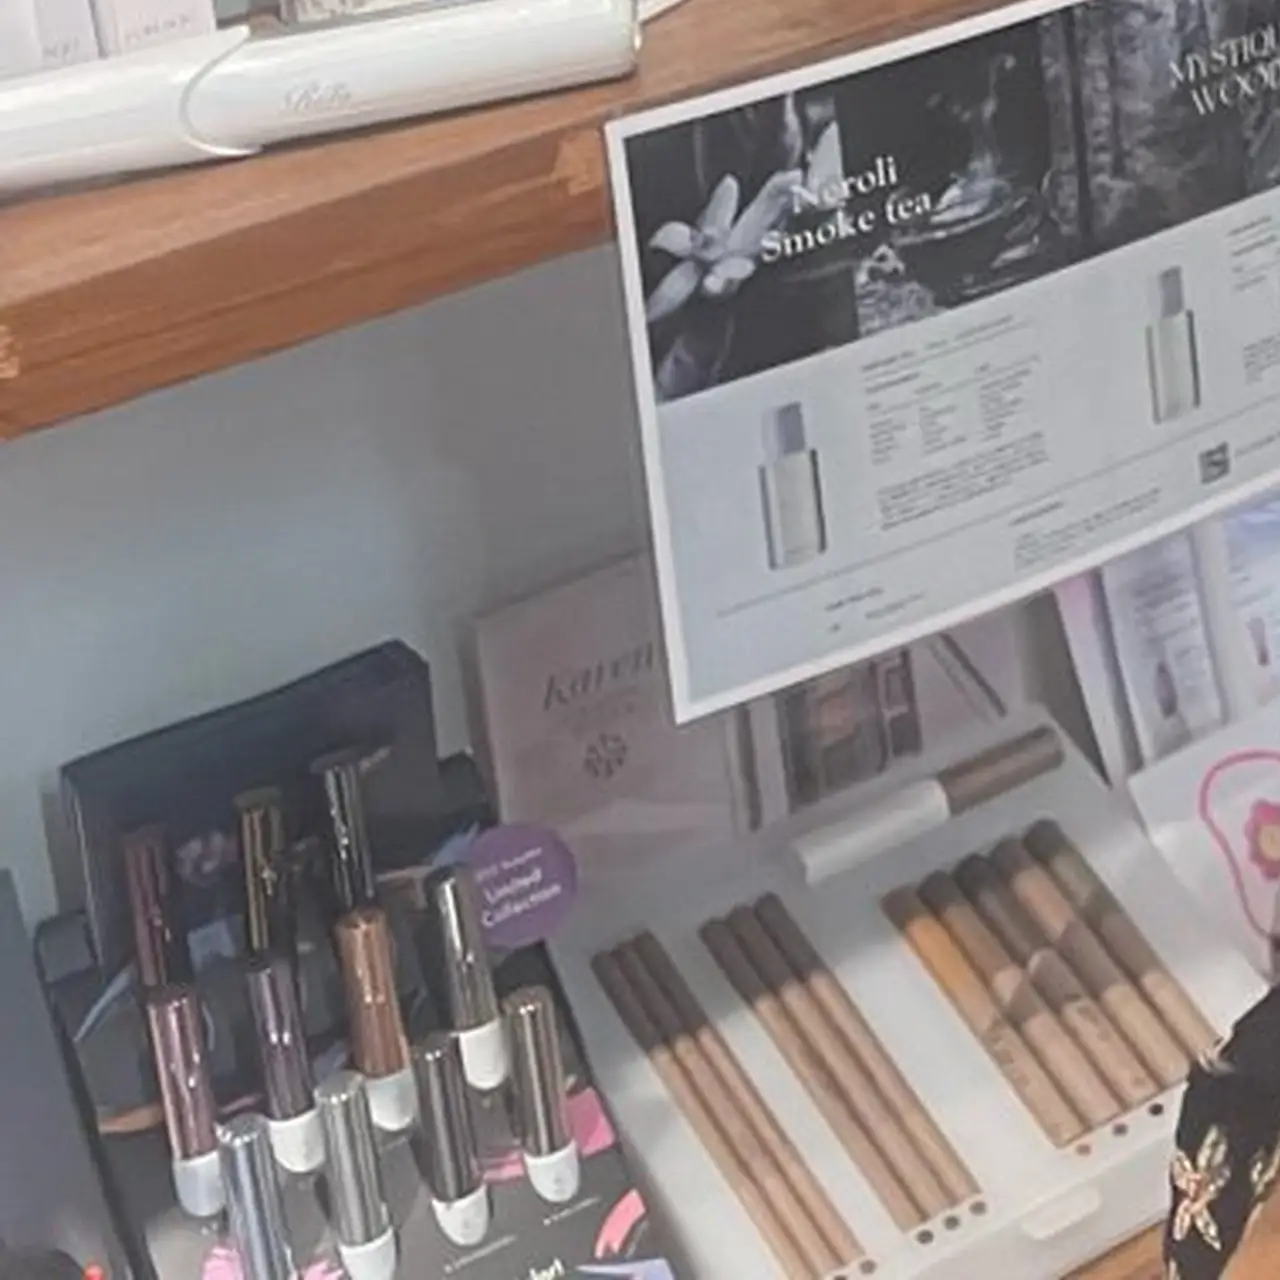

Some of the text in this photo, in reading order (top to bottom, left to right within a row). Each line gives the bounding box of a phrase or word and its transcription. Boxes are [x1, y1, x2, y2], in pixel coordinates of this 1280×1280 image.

[790, 155, 899, 215] Neroli
[760, 190, 932, 263] Smoke tea
